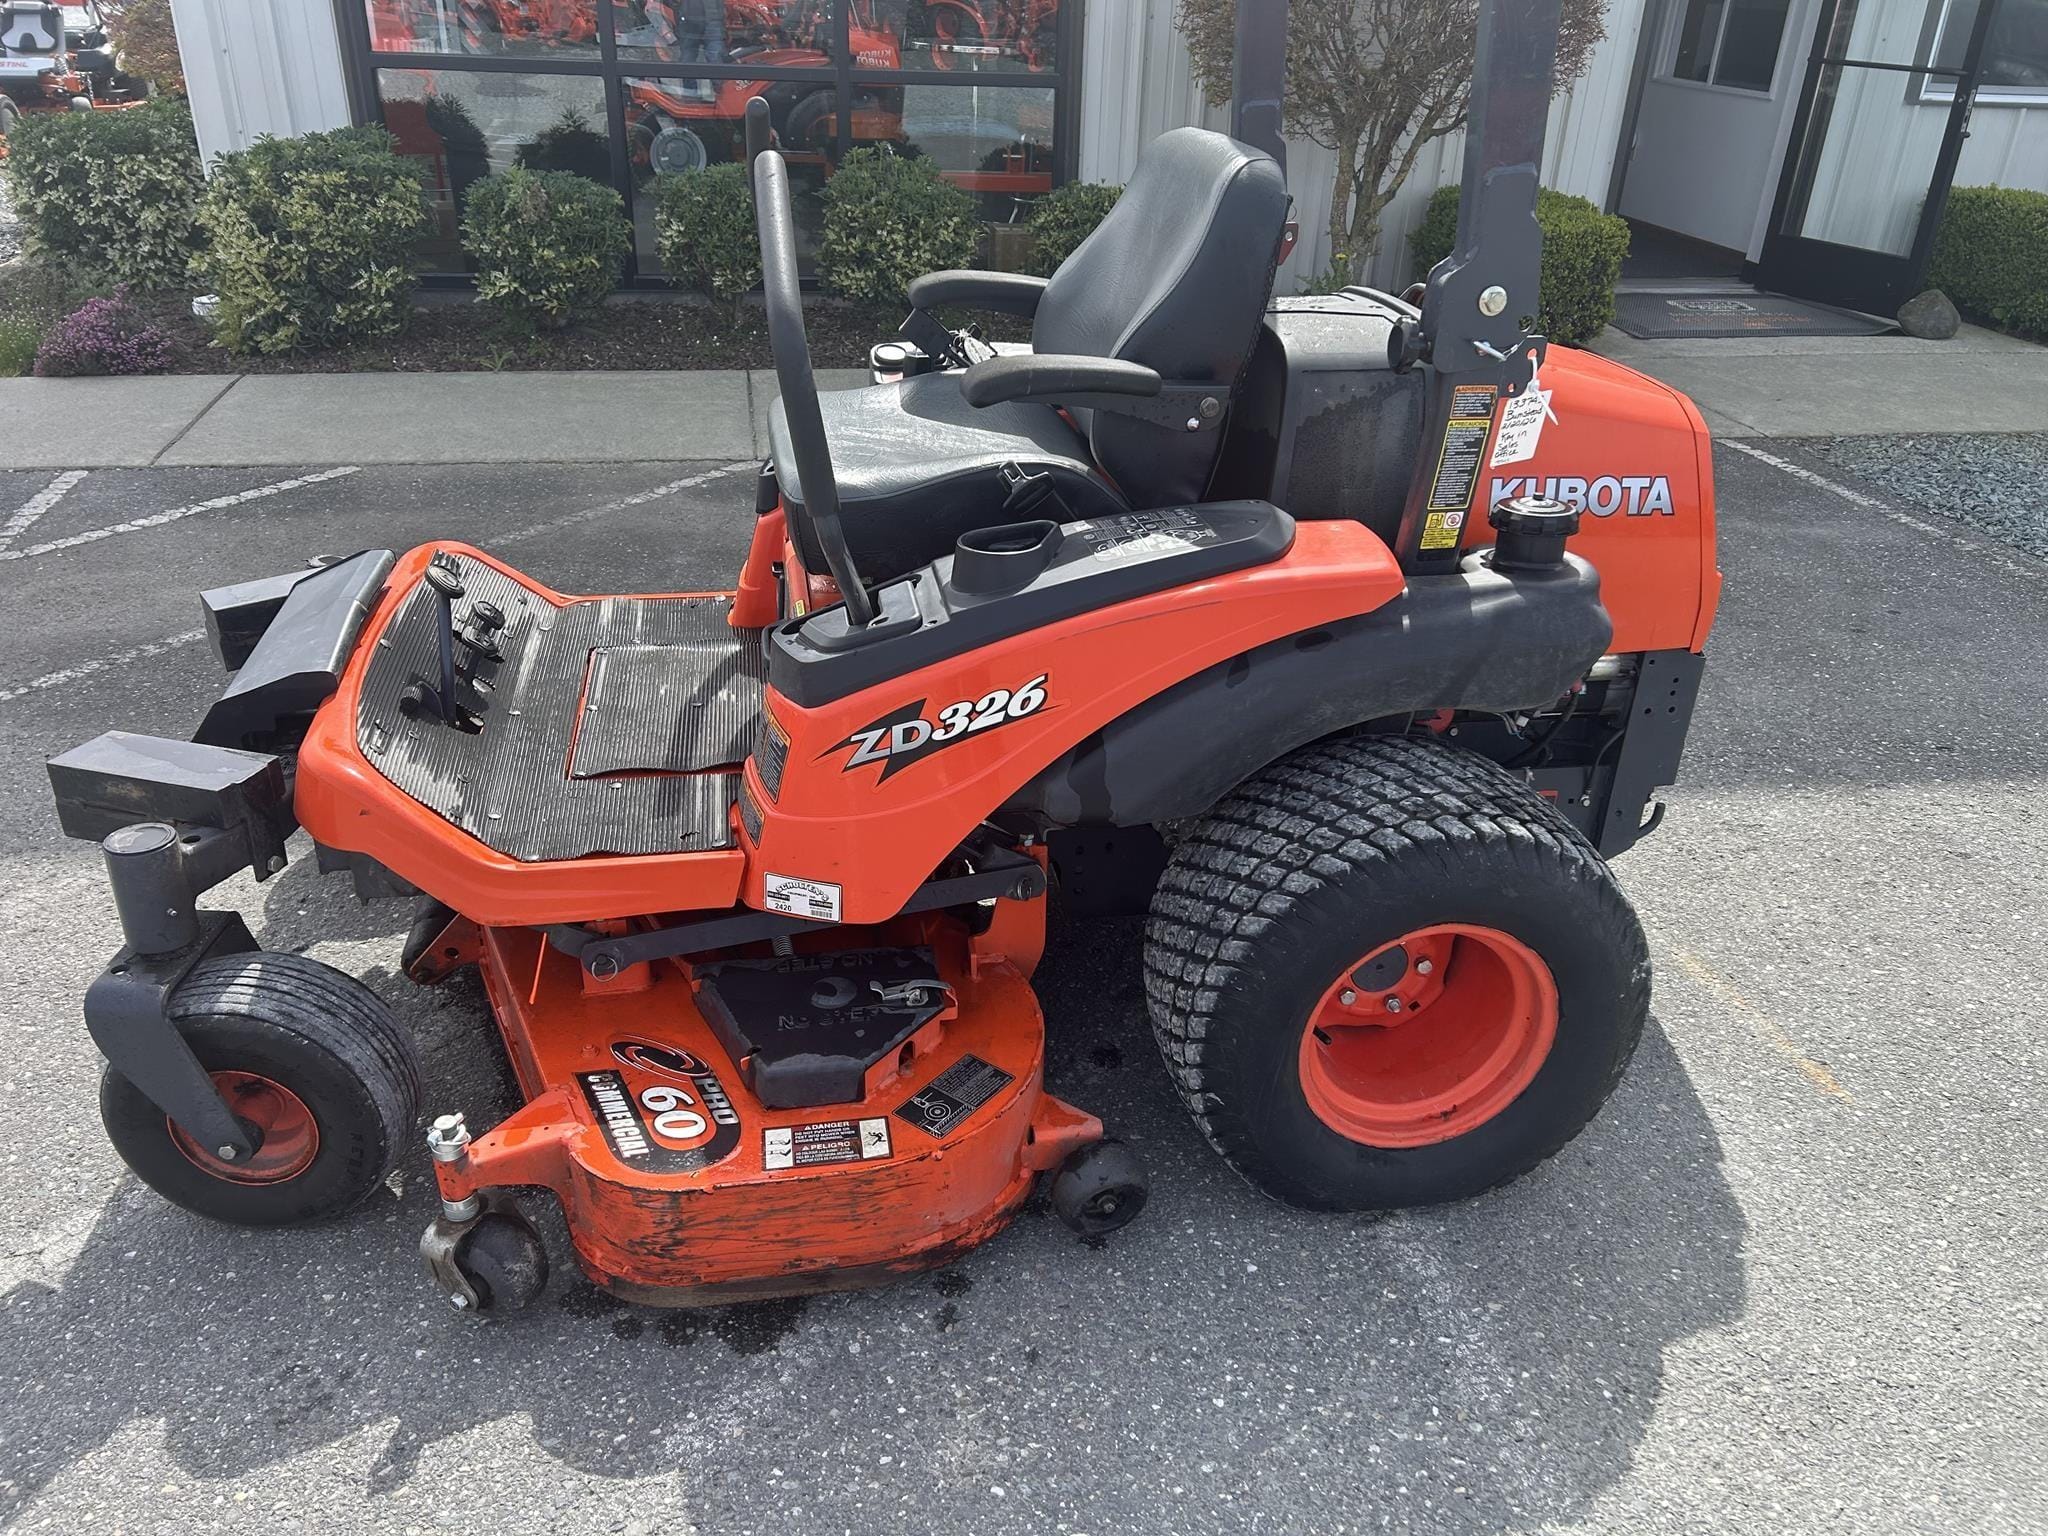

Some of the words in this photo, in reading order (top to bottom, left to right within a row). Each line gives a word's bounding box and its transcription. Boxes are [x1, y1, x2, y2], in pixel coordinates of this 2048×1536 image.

[845, 673, 1049, 769] ZD326
[774, 902, 792, 912] 2420
[588, 1073, 651, 1158] COMMERCIAL
[641, 1086, 707, 1139] 60
[694, 1077, 739, 1125] PRO
[811, 1141, 850, 1149] PELIGRO
[812, 1121, 850, 1131] DANGER
